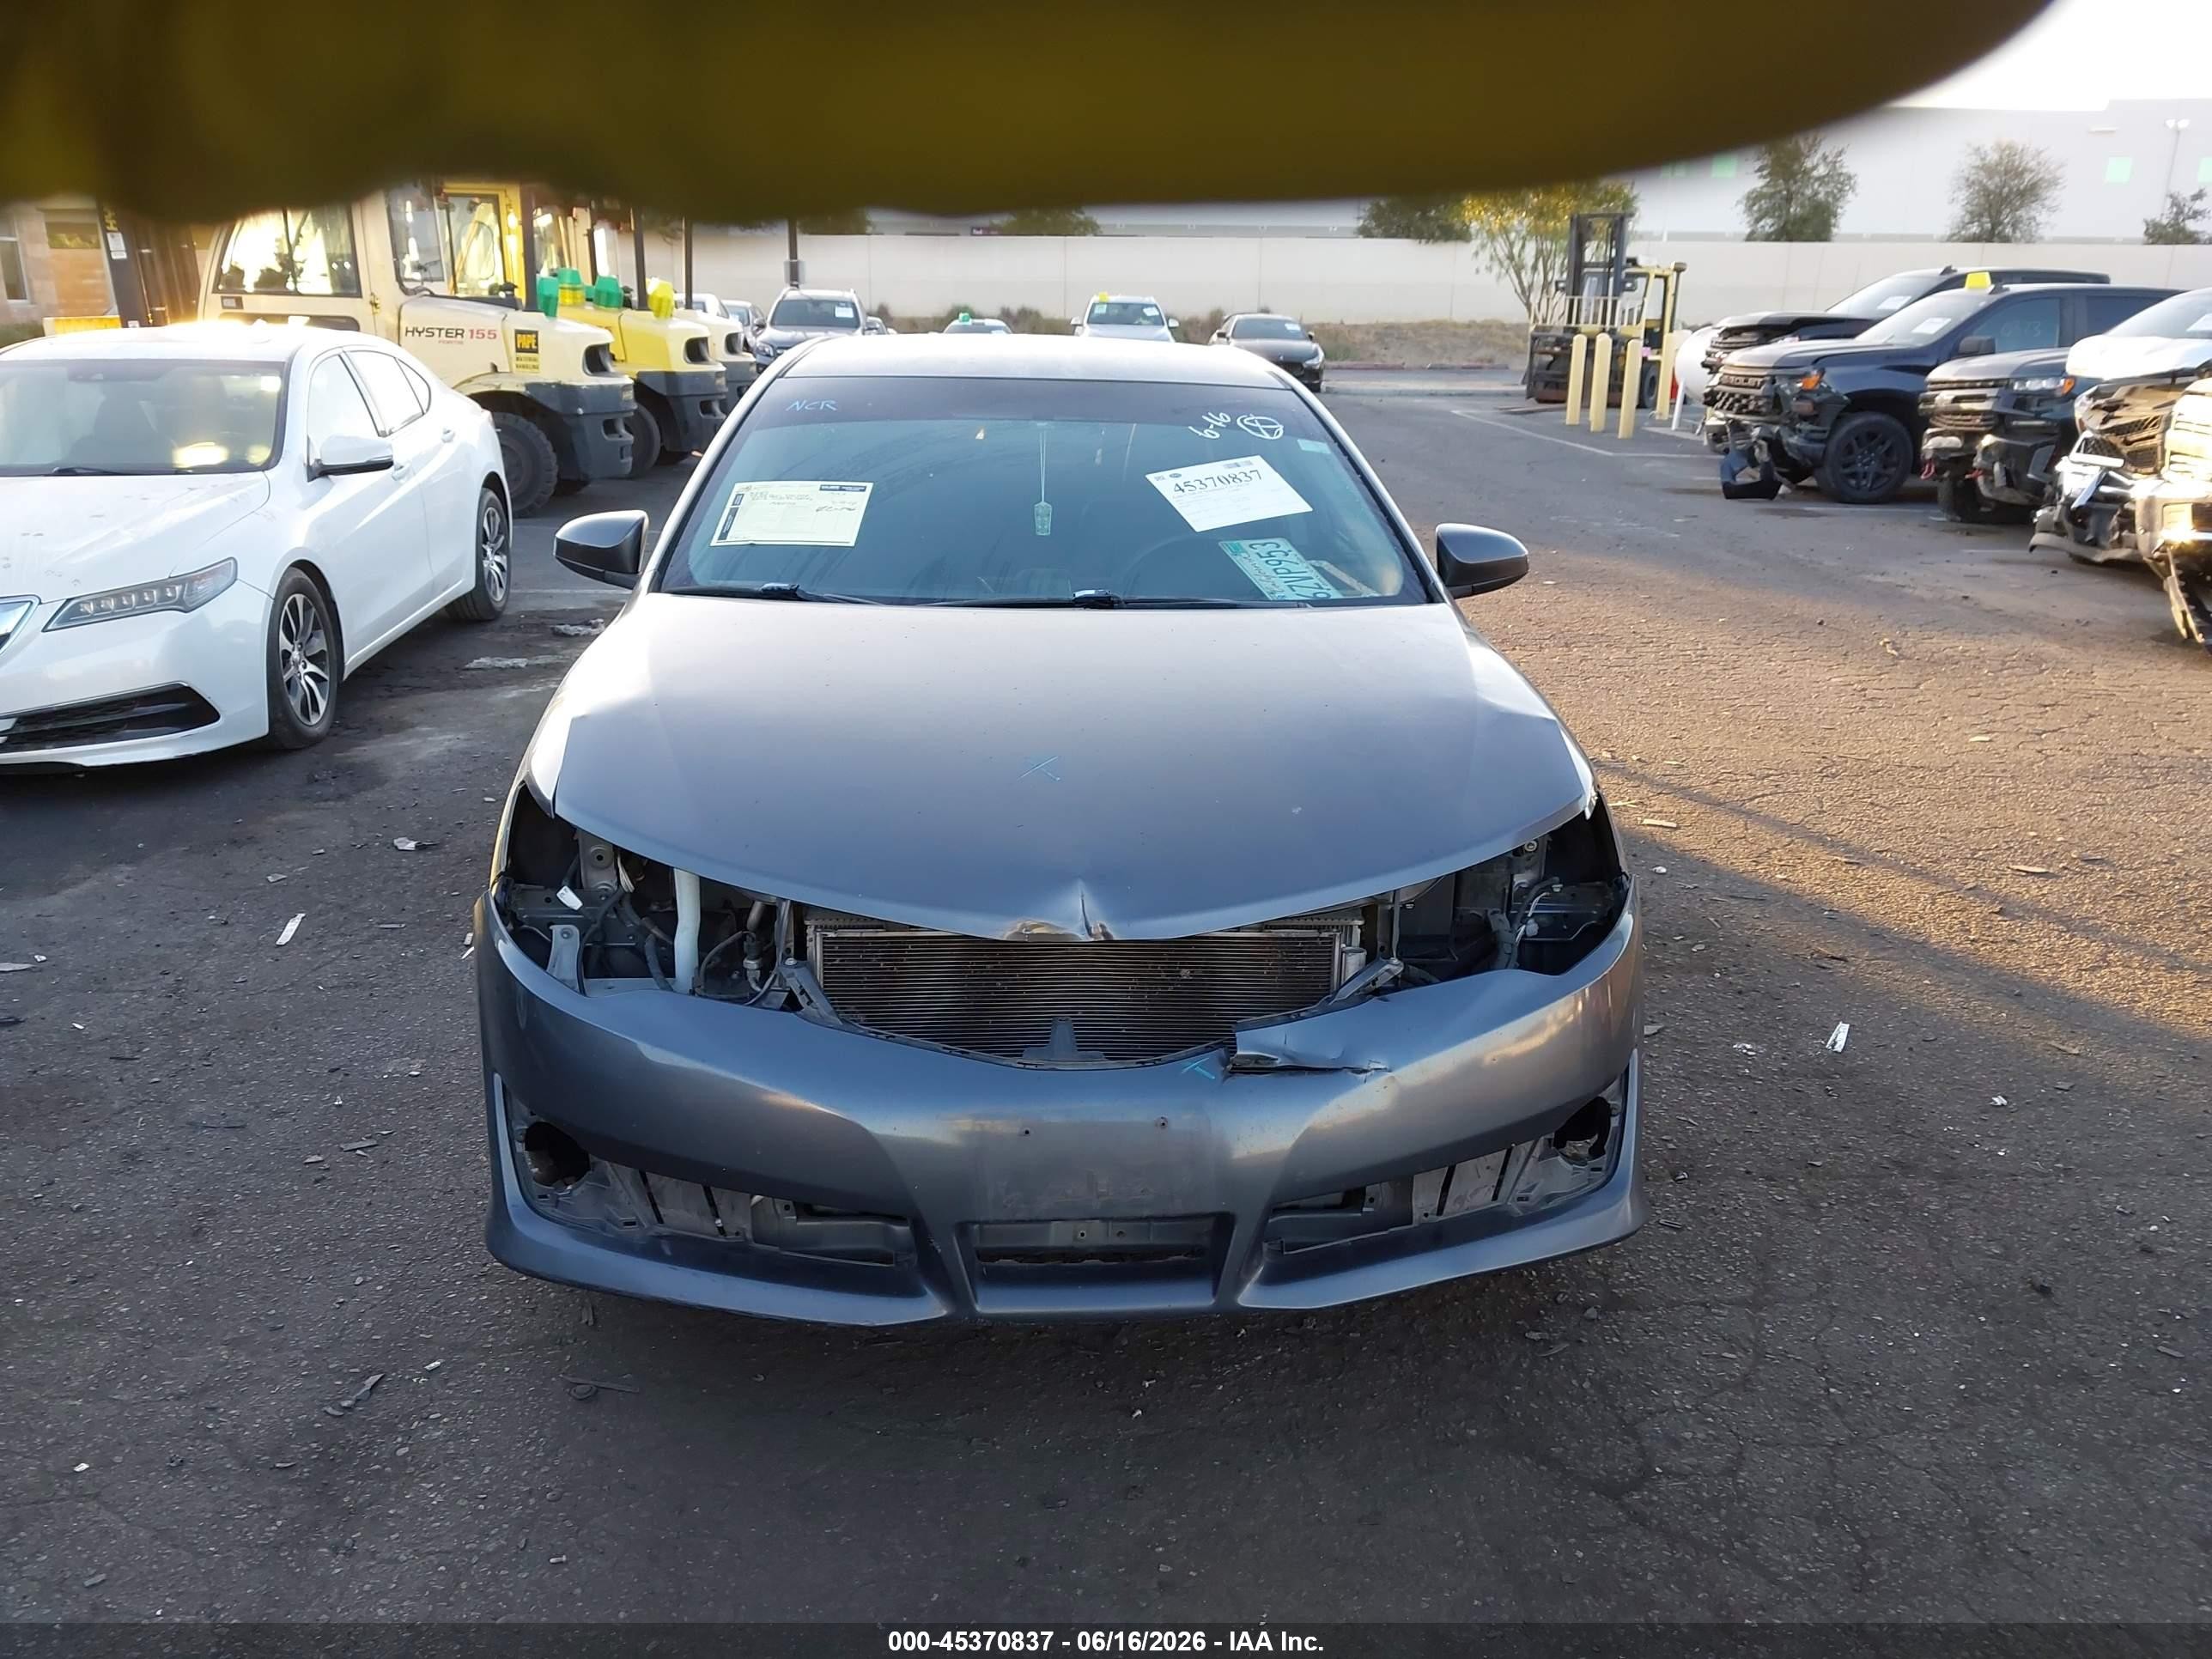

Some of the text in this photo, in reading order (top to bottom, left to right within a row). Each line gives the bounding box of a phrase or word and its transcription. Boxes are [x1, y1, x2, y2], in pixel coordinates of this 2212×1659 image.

[404, 326, 497, 340] HYSTER 155
[785, 399, 838, 412] NCR
[1188, 411, 1231, 439] 6-16
[1173, 469, 1263, 494] 45370837
[1249, 541, 1331, 599] 6ZVP953
